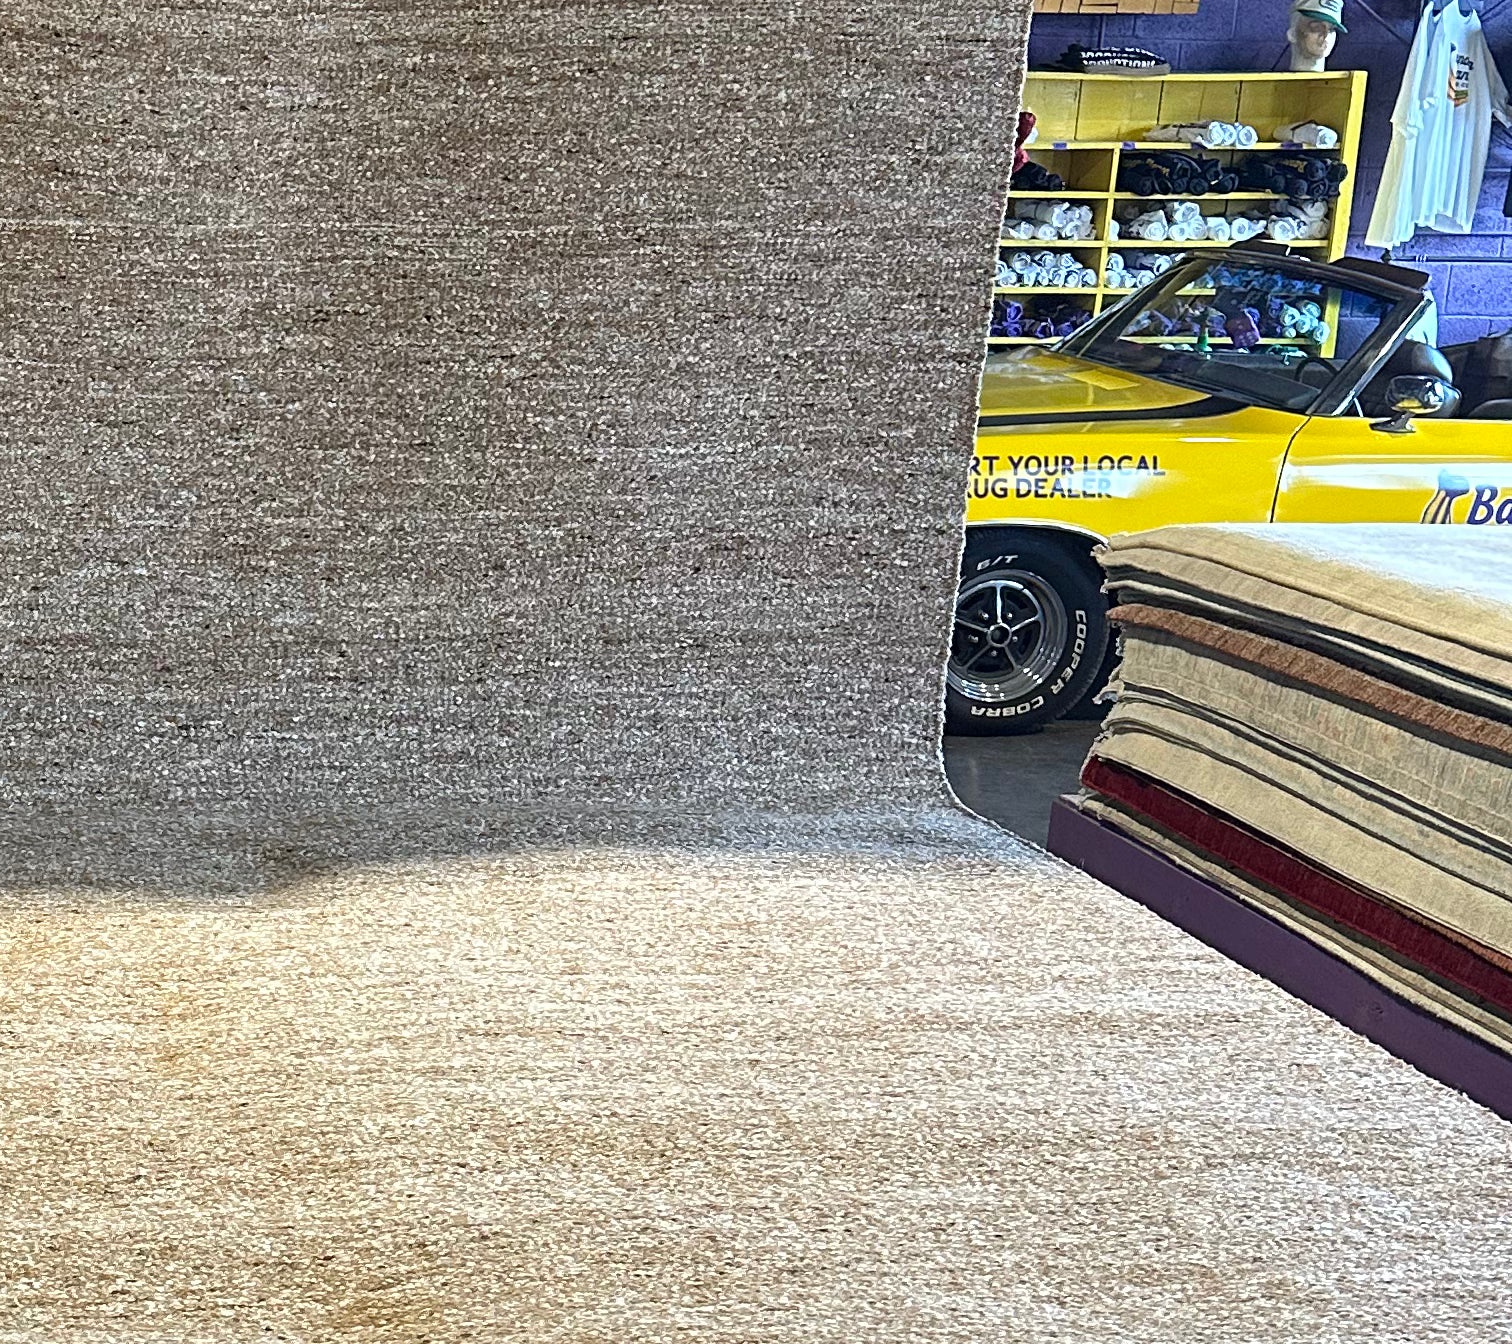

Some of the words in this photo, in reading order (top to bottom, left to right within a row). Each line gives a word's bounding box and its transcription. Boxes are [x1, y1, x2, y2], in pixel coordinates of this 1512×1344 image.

[1007, 455, 1075, 476] YOUR
[1083, 455, 1166, 476] LOCAL
[966, 477, 1008, 499] UG
[1015, 477, 1113, 499] DEALER
[1050, 609, 1087, 695] COOPER
[970, 695, 1045, 717] COBRA
